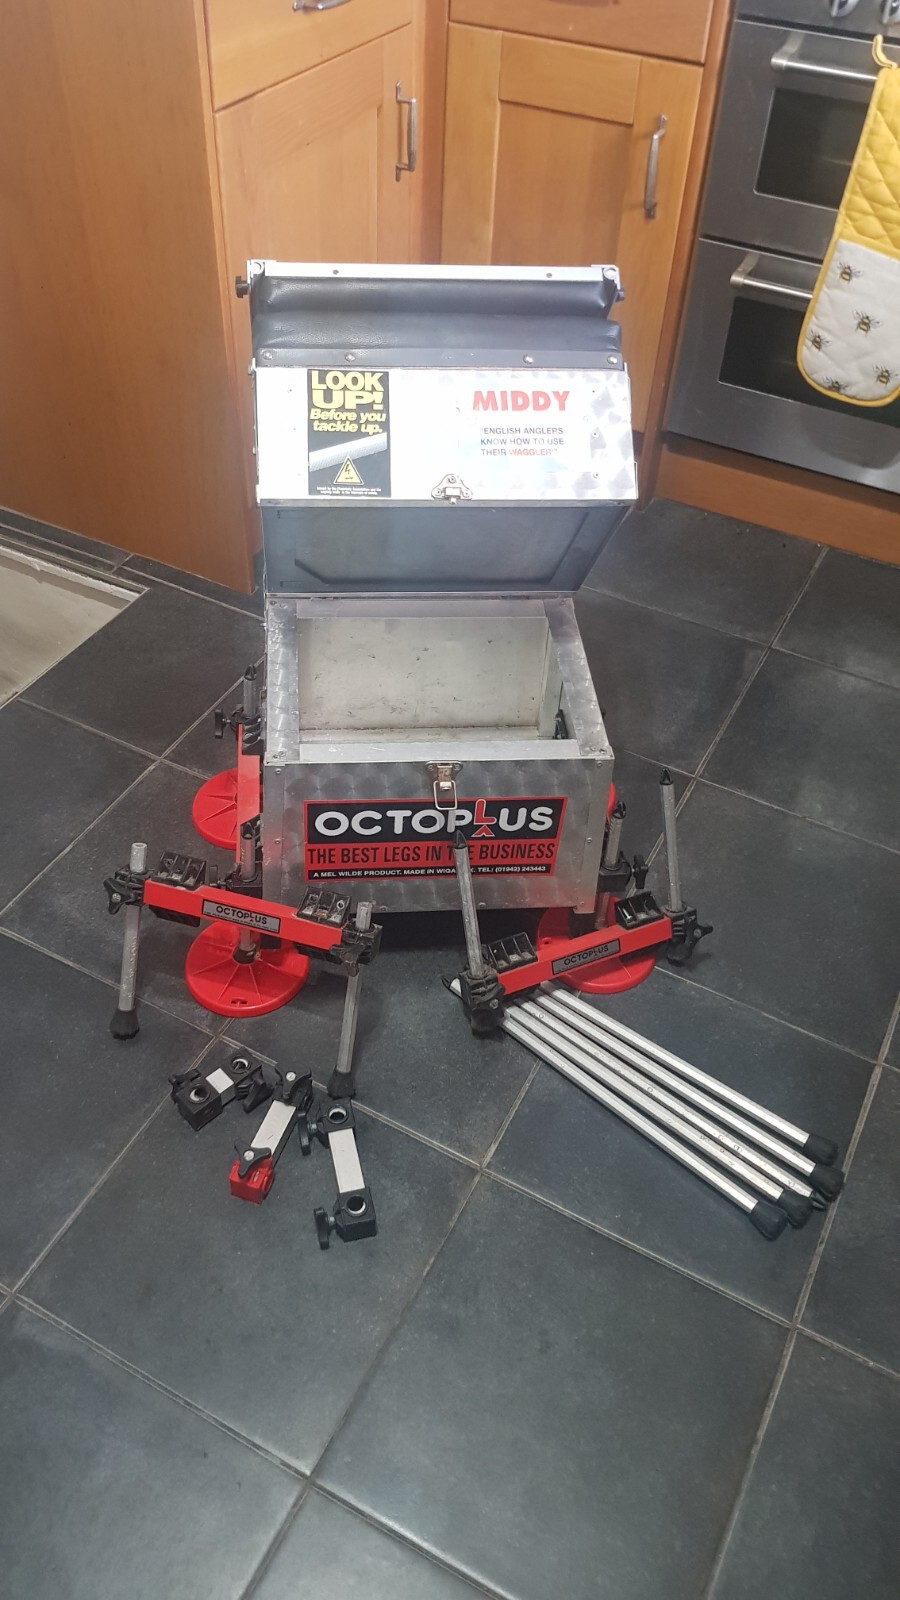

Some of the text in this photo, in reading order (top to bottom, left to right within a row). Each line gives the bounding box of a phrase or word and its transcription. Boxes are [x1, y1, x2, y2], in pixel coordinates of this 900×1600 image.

[311, 370, 384, 391] LOOK
[312, 390, 384, 410] UP!
[472, 390, 570, 411] MIDDY
[310, 408, 387, 424] Before you
[313, 420, 383, 435] tackle up.
[523, 427, 564, 435] ANGLERS
[480, 438, 507, 446] KNOW
[509, 438, 531, 446] HOW
[547, 438, 565, 446] USE
[480, 448, 507, 456] THEIR
[314, 798, 554, 837] OCTOPLUS
[307, 842, 555, 865] THE BEST LEGS IN TE BUSINESS
[338, 870, 363, 878] WILDE
[495, 865, 520, 873] (01942)
[216, 905, 268, 925] OCTOPLUS
[563, 944, 609, 966] OCTOPLUS
